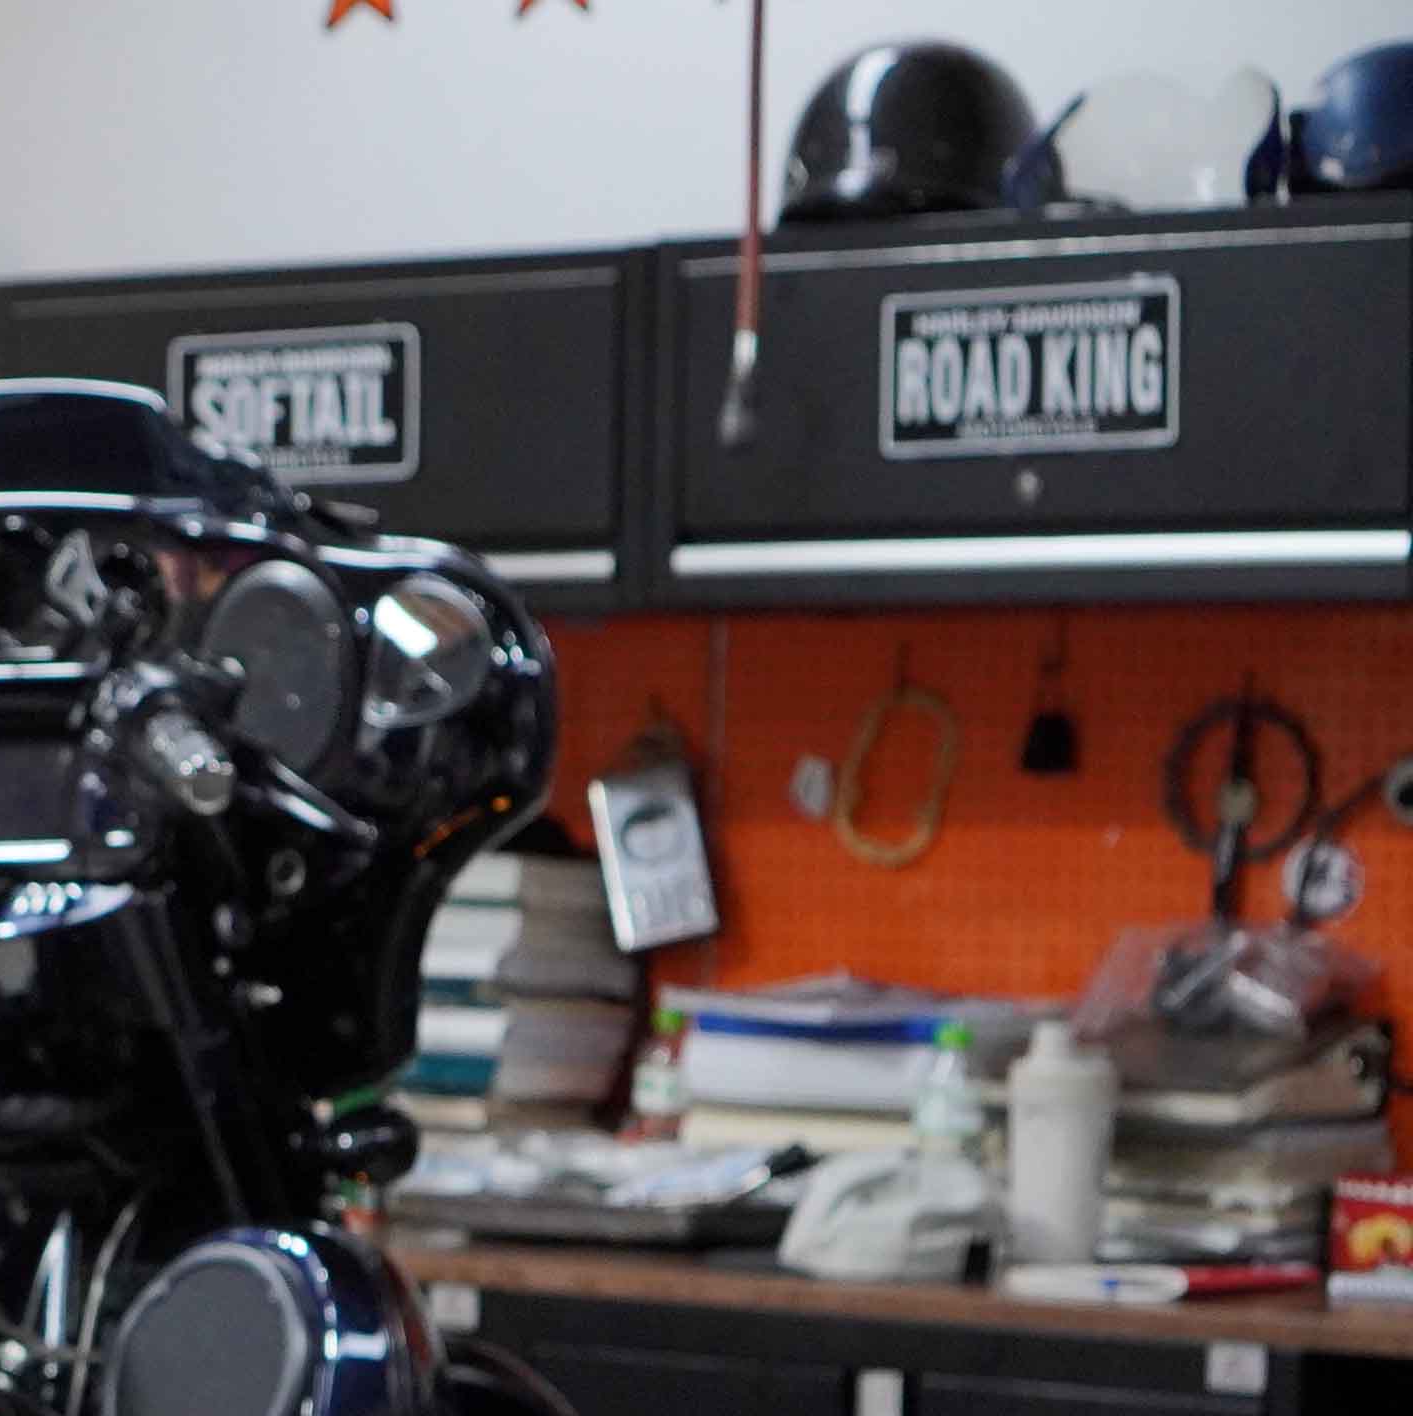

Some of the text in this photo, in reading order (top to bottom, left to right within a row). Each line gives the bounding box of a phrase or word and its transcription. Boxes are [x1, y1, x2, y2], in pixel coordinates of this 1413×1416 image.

[191, 371, 397, 451] SOFTAIL
[896, 322, 1163, 426] ROAD KING
